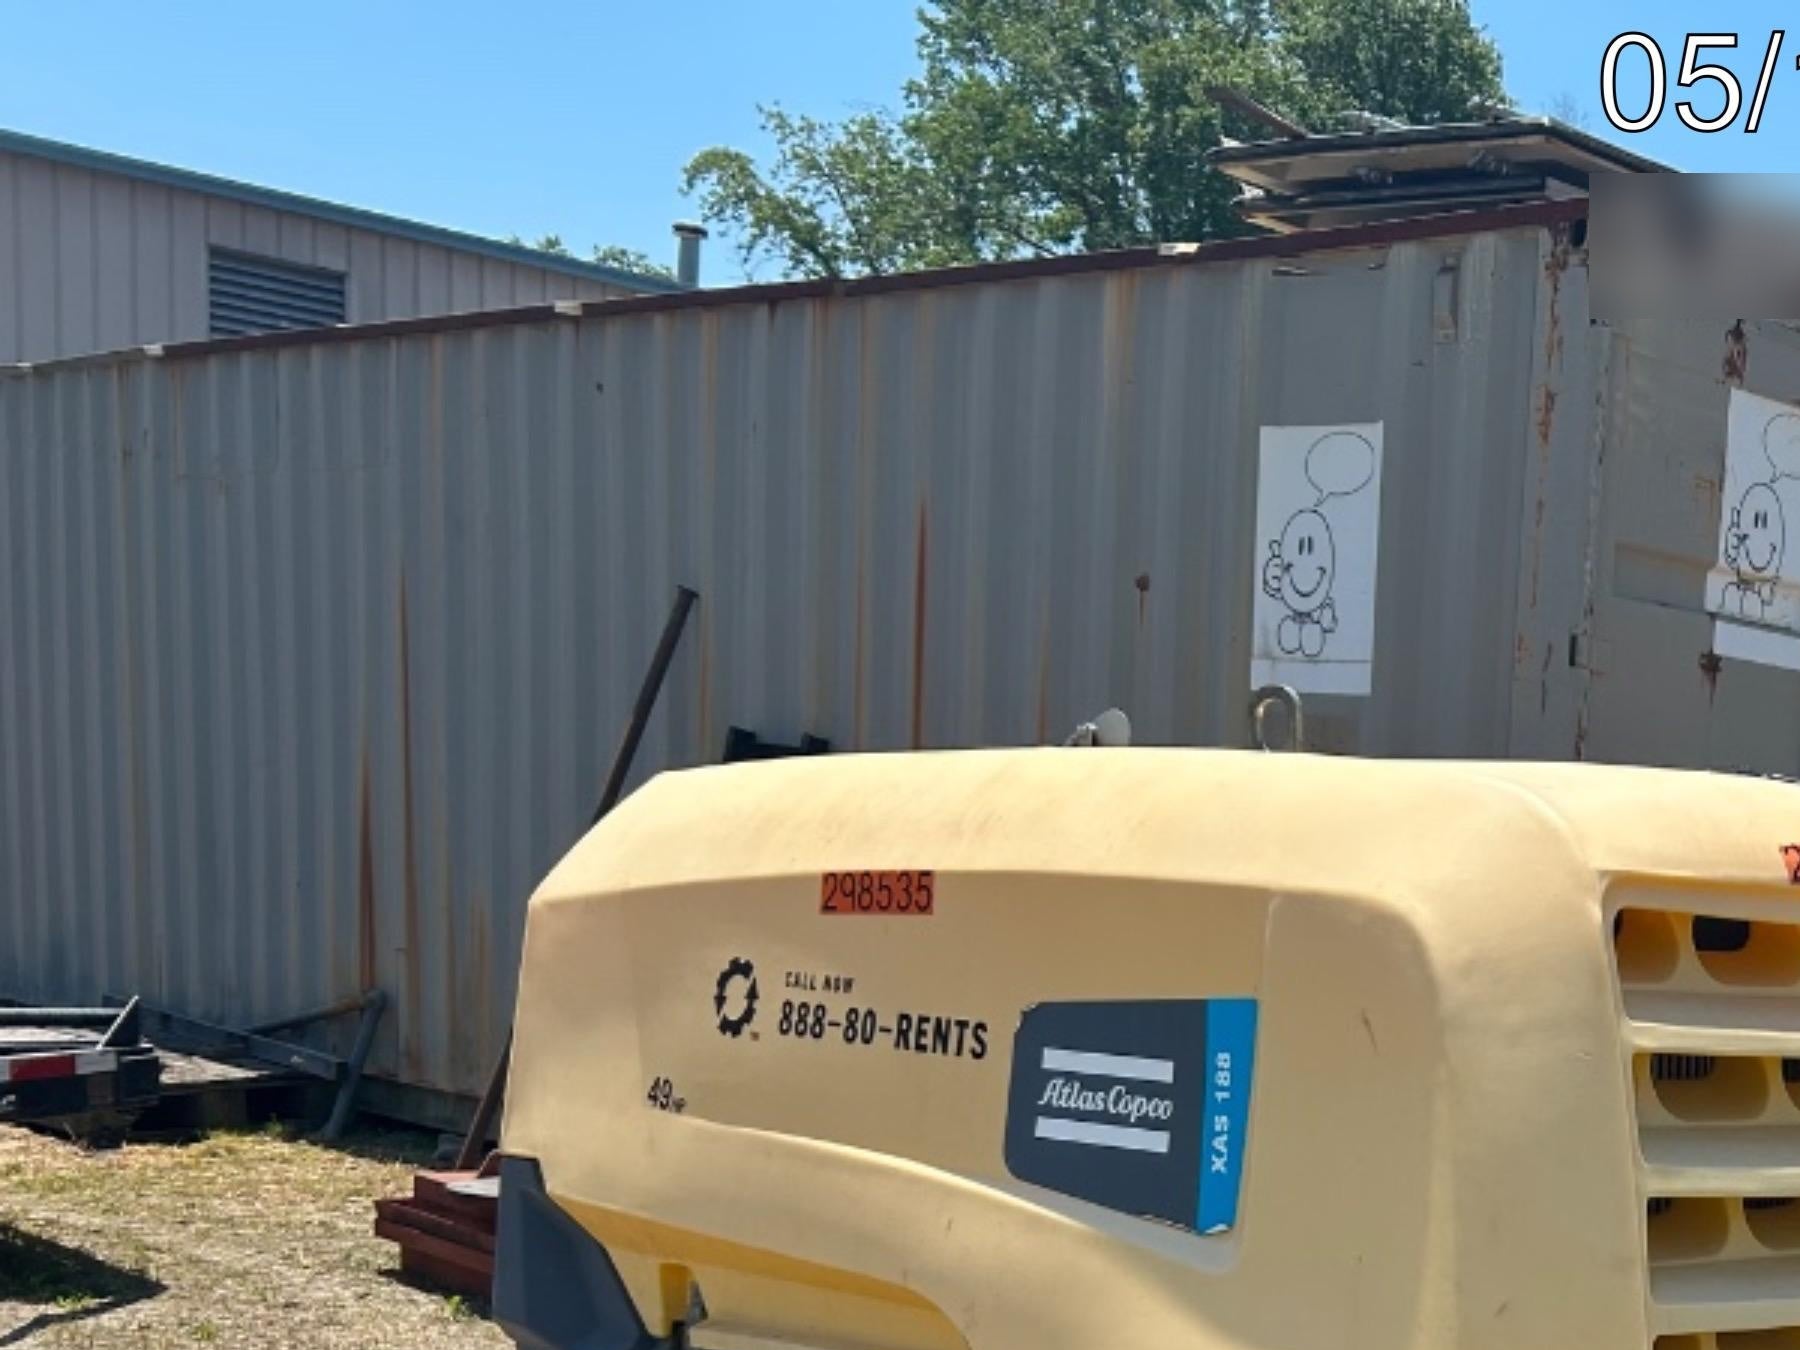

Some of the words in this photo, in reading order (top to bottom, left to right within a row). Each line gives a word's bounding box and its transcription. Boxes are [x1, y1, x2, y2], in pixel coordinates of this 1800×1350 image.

[821, 869, 934, 913] 298535
[785, 971, 817, 991] CALL
[821, 974, 855, 994] NOW
[778, 999, 989, 1060] 888-80-RENTS
[647, 1075, 673, 1111] 49
[1037, 1076, 1105, 1112] Atlas
[1106, 1084, 1174, 1123] Copco
[1214, 1052, 1232, 1103] 188
[1211, 1114, 1229, 1174] XAS
